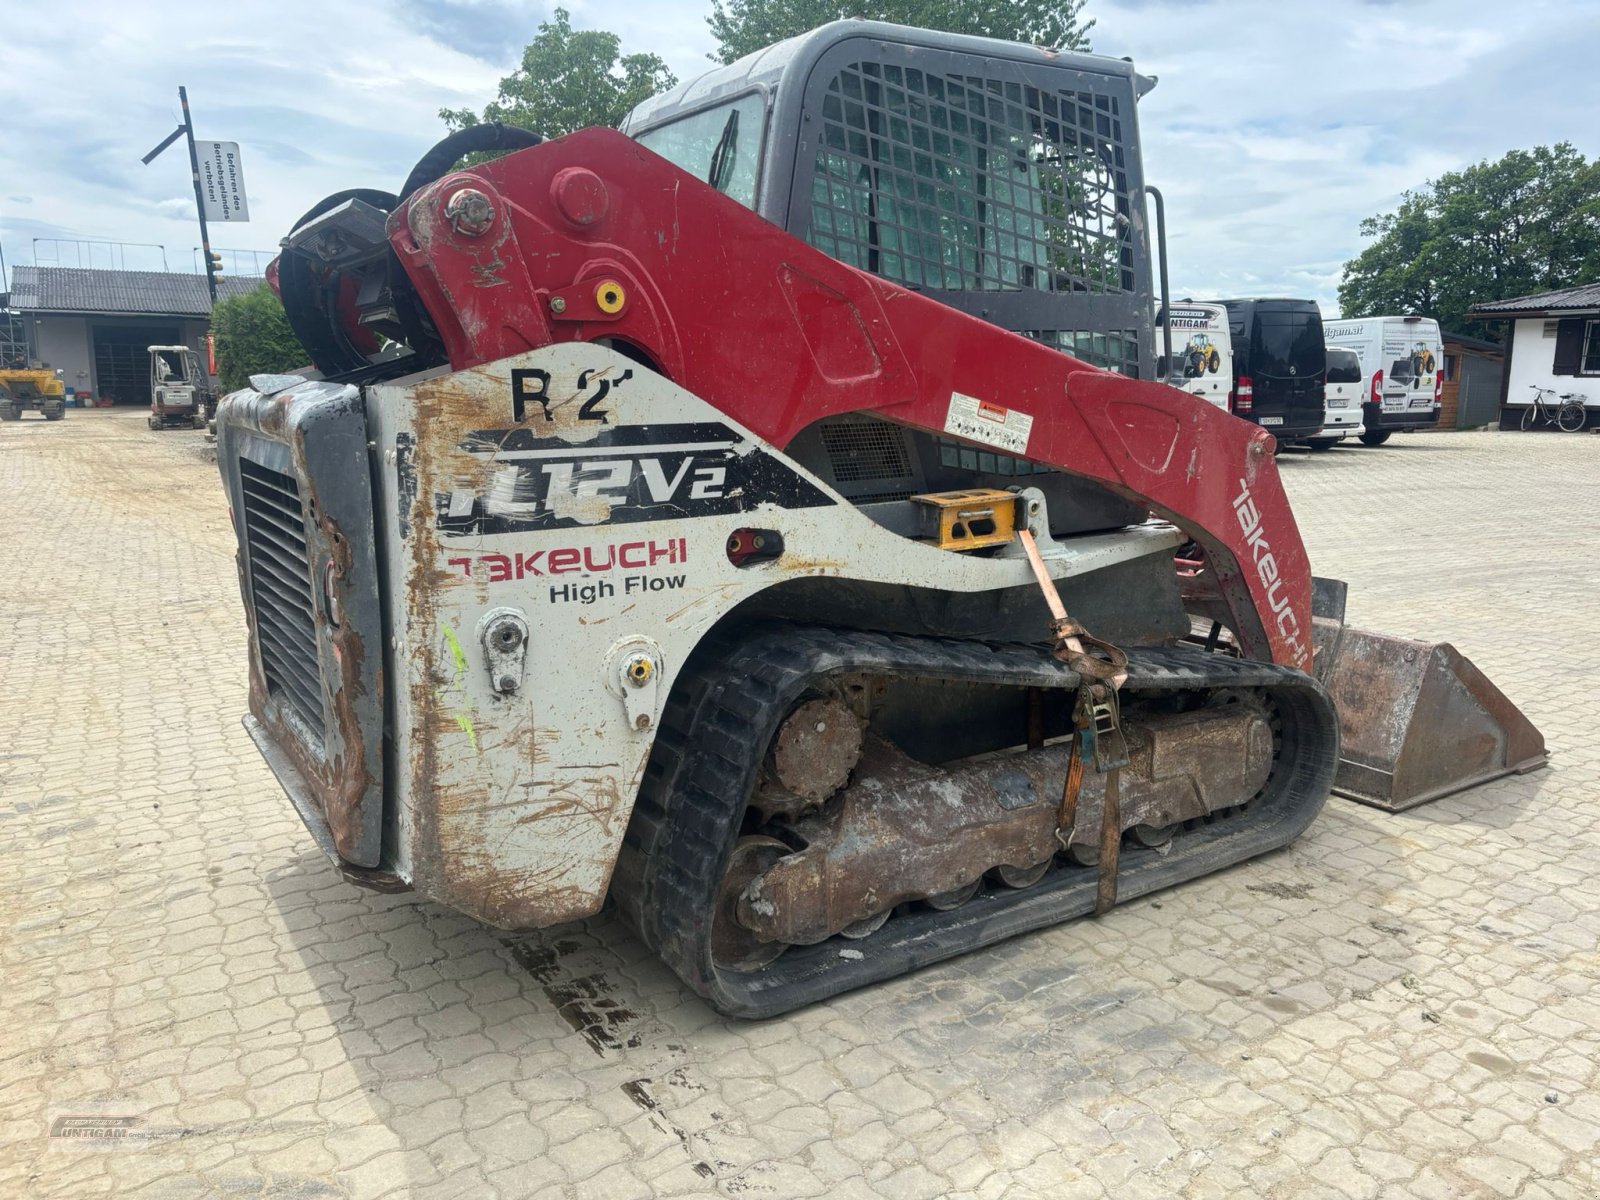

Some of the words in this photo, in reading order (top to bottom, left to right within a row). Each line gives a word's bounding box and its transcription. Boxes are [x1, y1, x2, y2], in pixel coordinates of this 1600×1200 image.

[204, 161, 217, 203] verboten!
[226, 153, 238, 193] Befahren
[1171, 319, 1208, 329] NTIGAM
[511, 368, 553, 422] R
[549, 580, 615, 604] High
[624, 574, 687, 595] Flow
